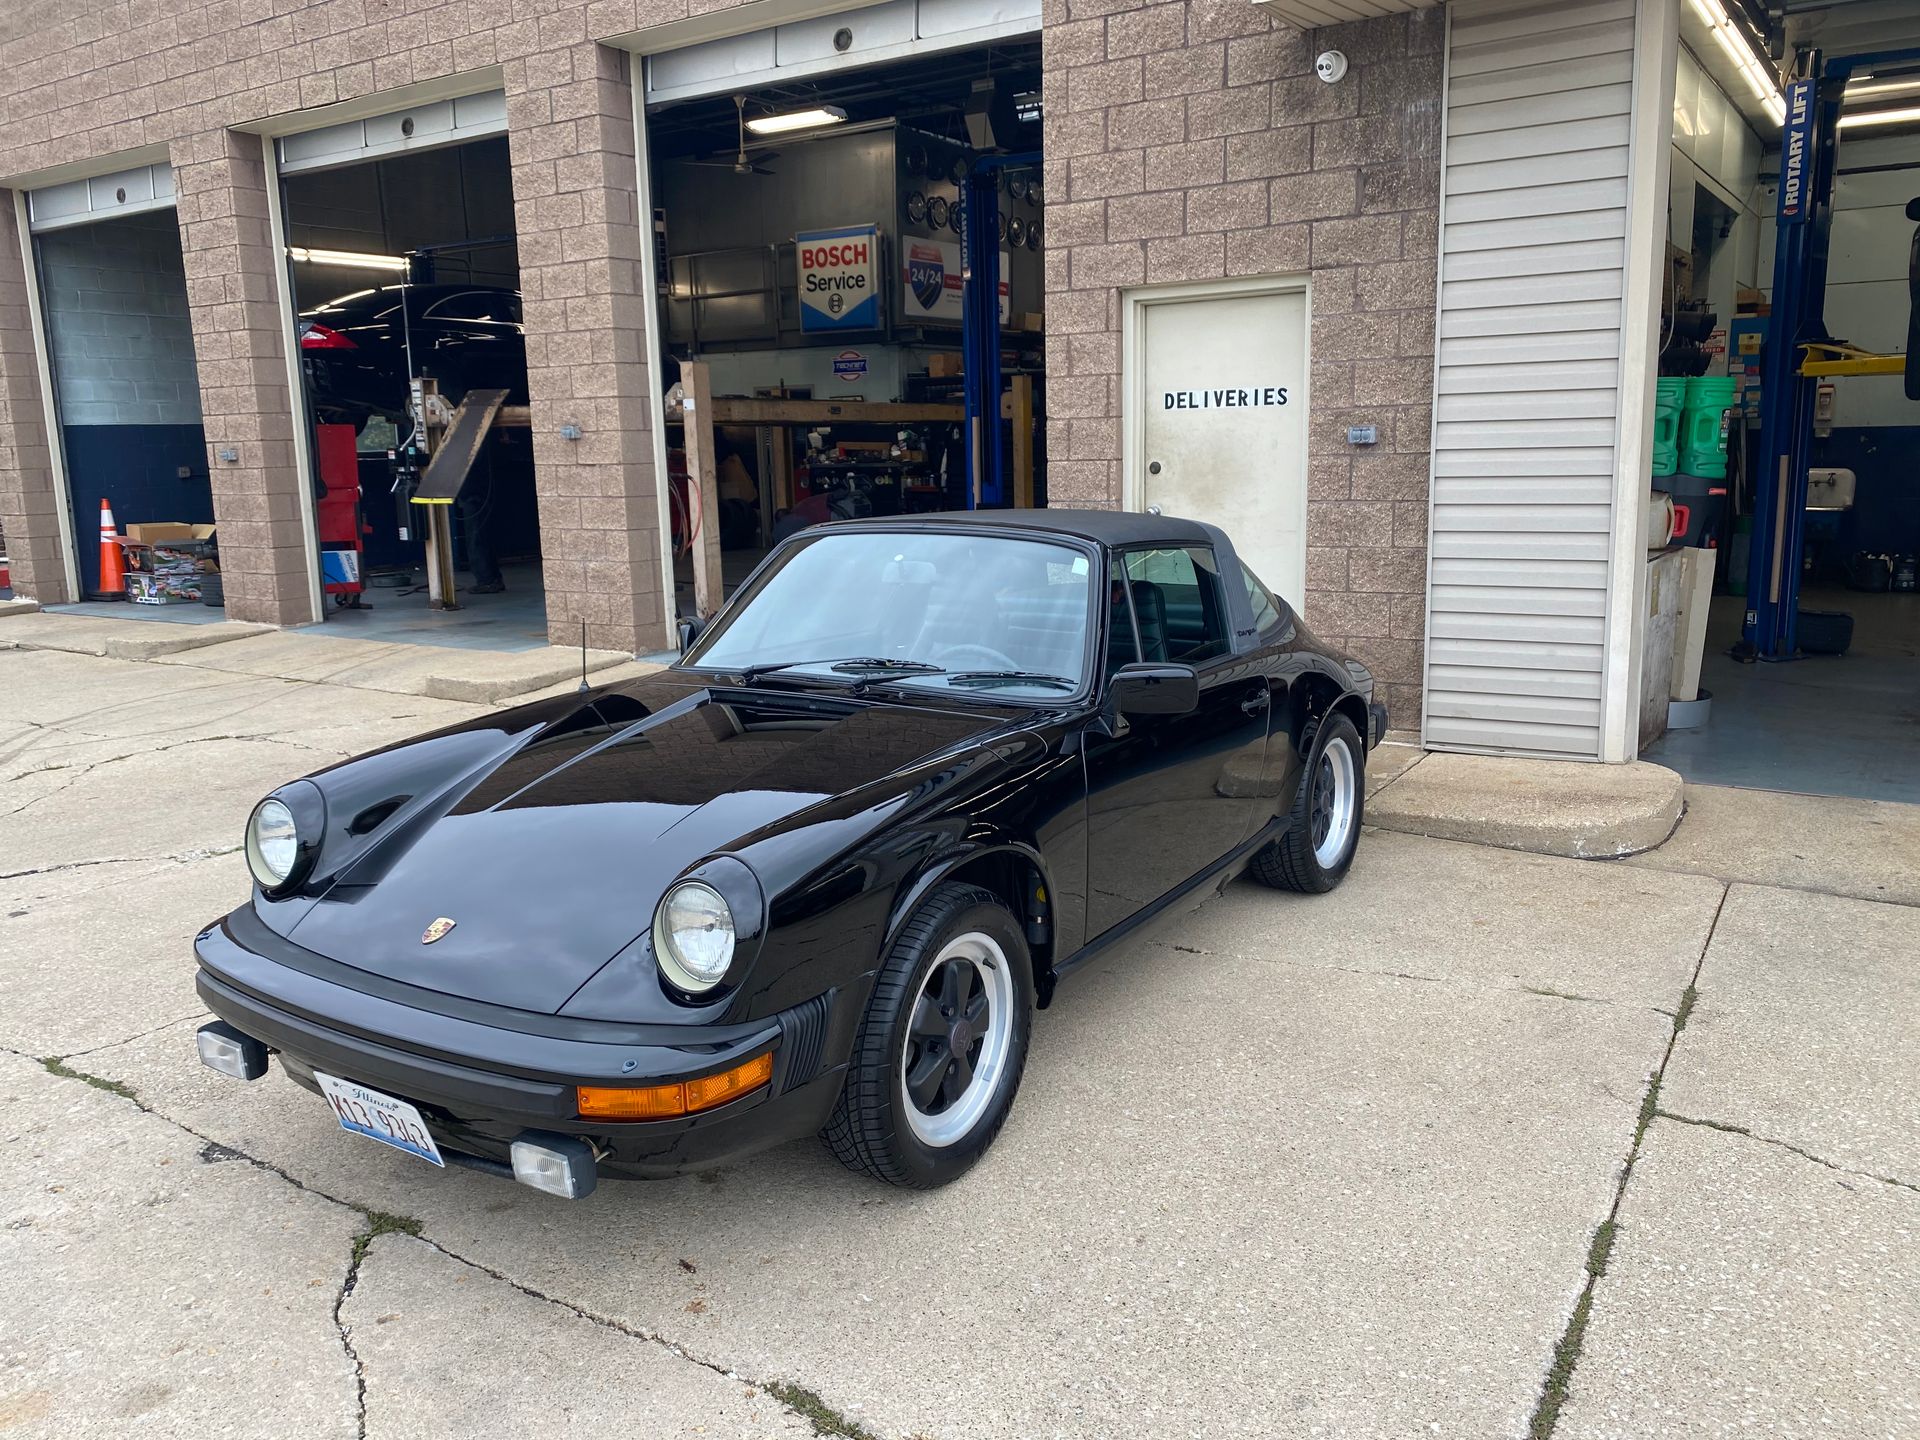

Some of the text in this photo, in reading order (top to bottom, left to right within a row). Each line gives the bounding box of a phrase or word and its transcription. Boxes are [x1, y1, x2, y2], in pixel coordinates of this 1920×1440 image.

[1792, 85, 1809, 125] LIFT
[1785, 131, 1805, 206] ROTARY
[802, 243, 867, 269] BOSCH
[806, 271, 865, 292] Service
[911, 268, 942, 286] 24/24
[1164, 387, 1288, 410] DELIVERIES
[351, 1088, 399, 1112] Illinois
[329, 1092, 432, 1153] K13 9343
